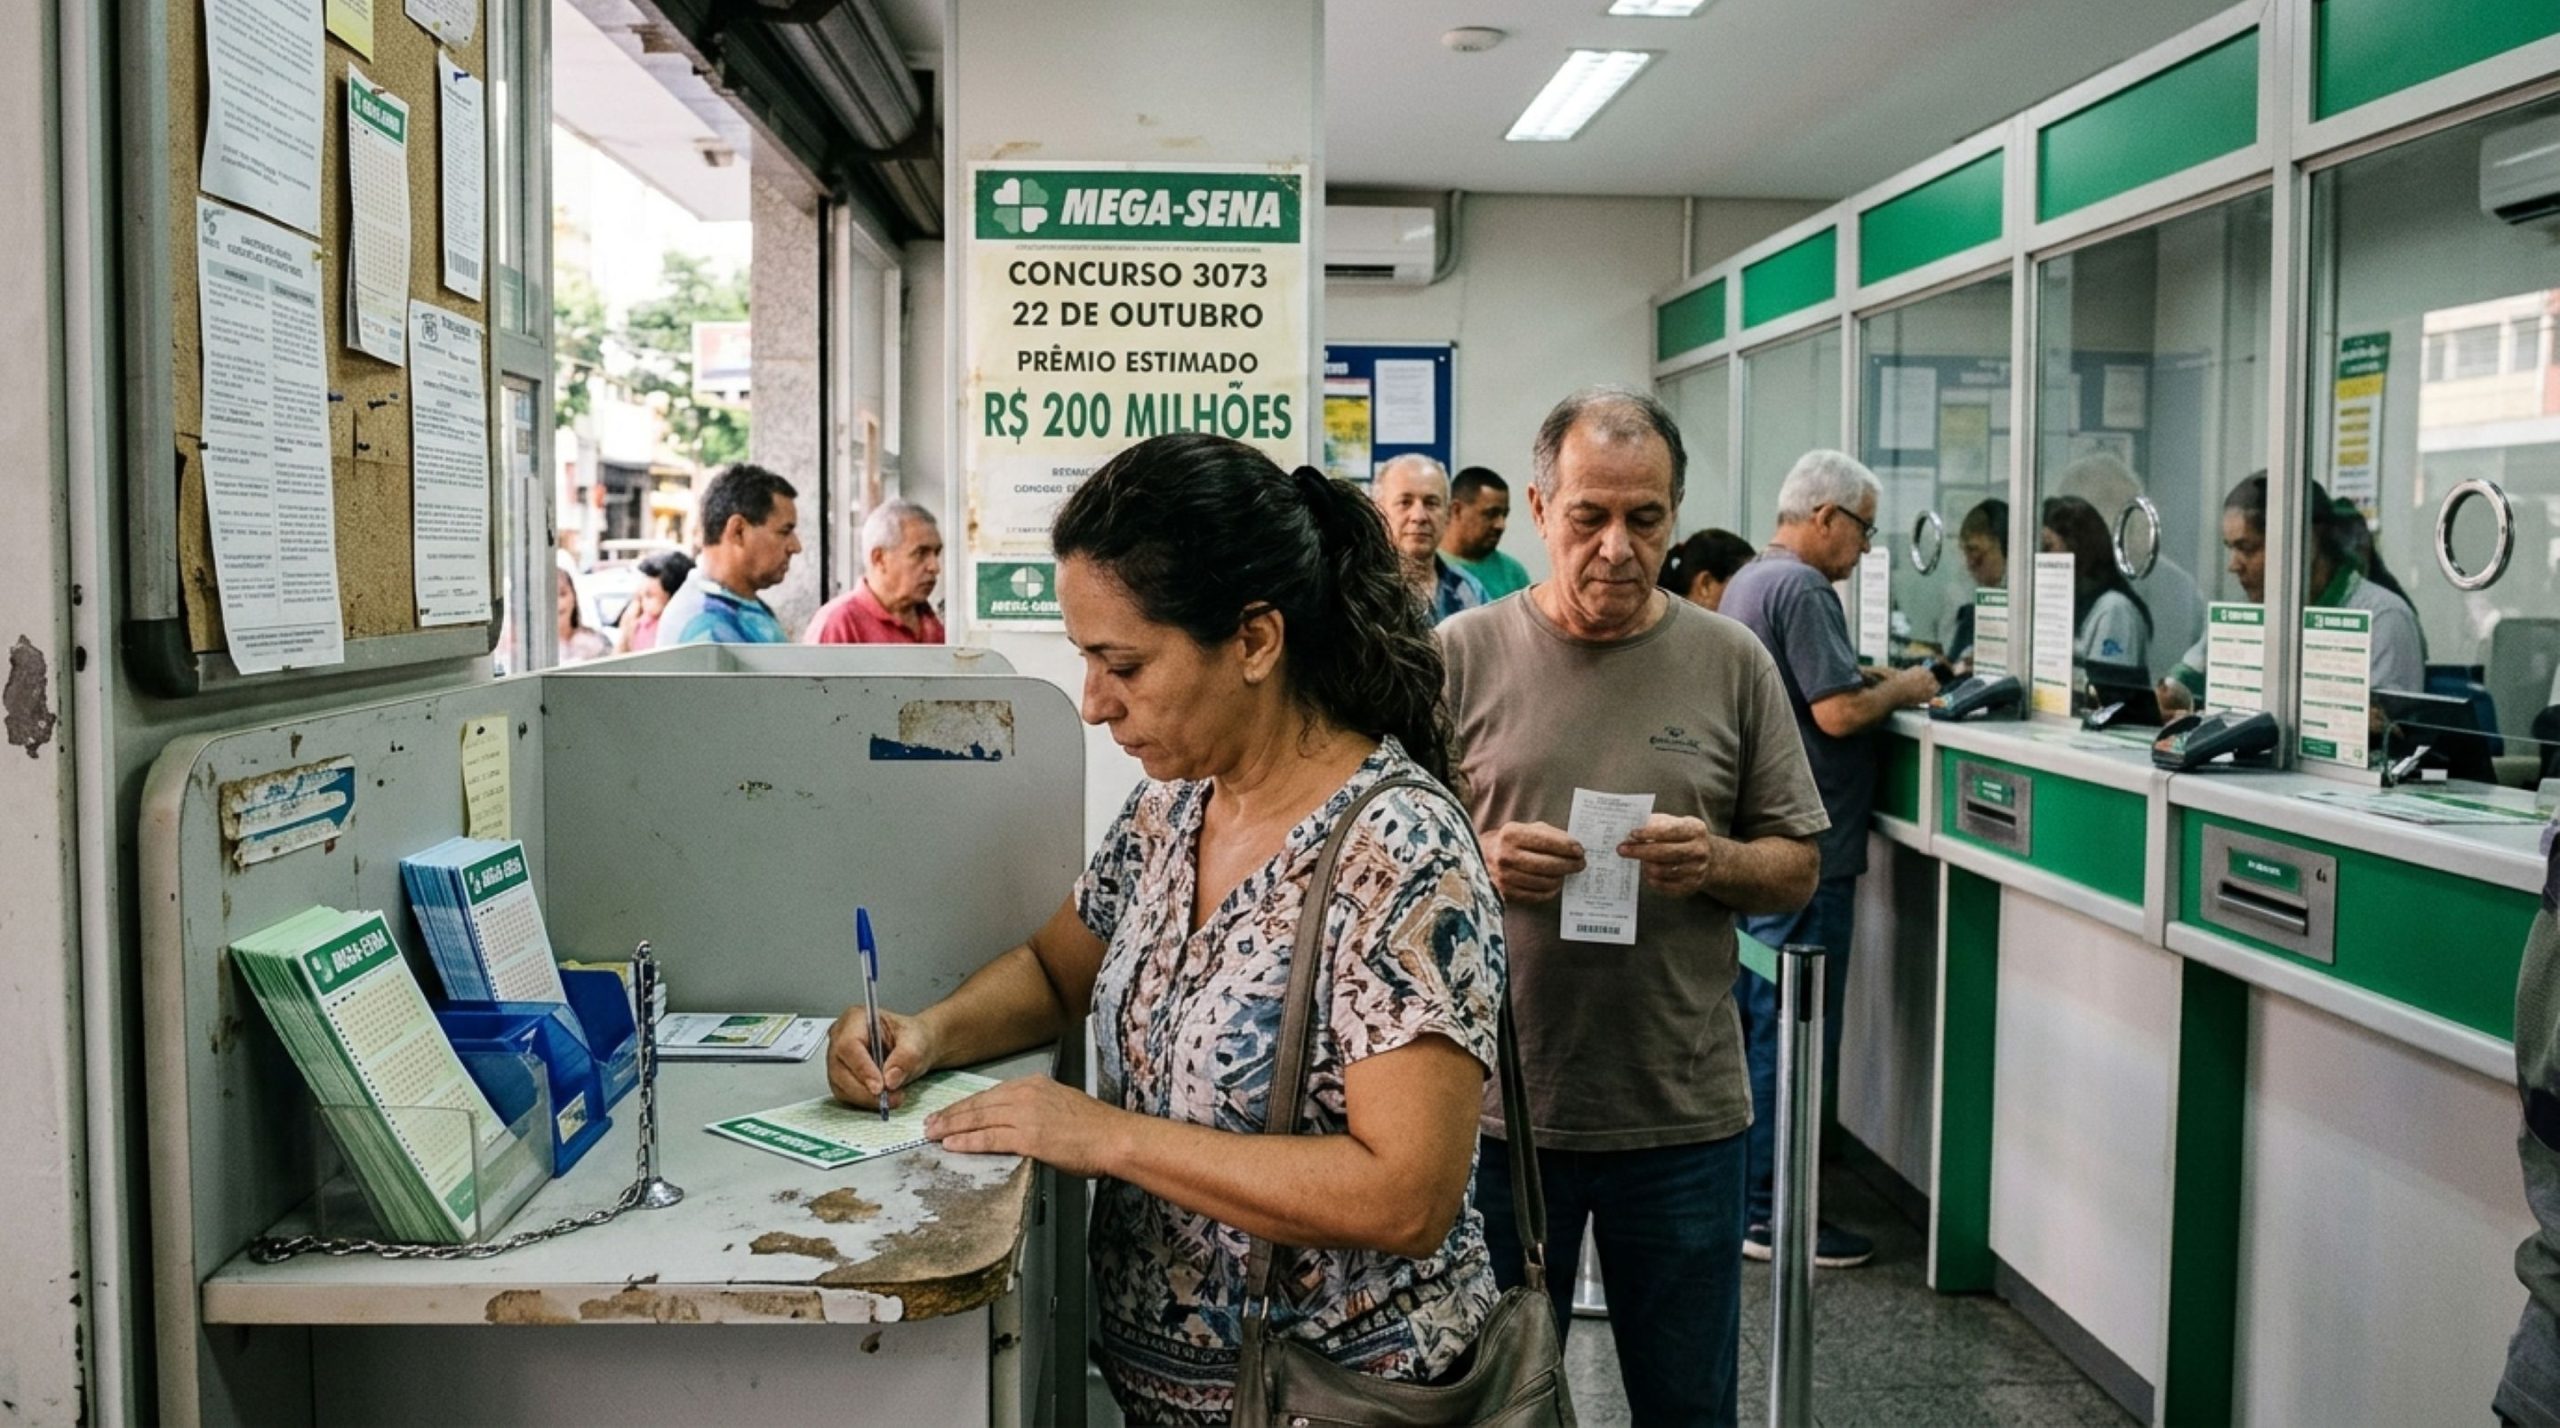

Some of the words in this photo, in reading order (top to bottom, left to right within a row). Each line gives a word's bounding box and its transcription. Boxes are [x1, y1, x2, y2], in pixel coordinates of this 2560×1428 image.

[1060, 188, 1281, 228] MEGA-SENA
[1008, 261, 1182, 288] CONCURSO
[1193, 262, 1268, 289] 3073
[1012, 302, 1048, 326] 22
[1061, 302, 1099, 327] DE
[1110, 302, 1264, 329] OUTUBRO
[1018, 344, 1116, 373] PRÊMIO
[1126, 351, 1259, 374] ESTIMADO
[985, 387, 1029, 444] R$
[1043, 391, 1111, 438] 200
[1124, 381, 1292, 440] MILHÕES
